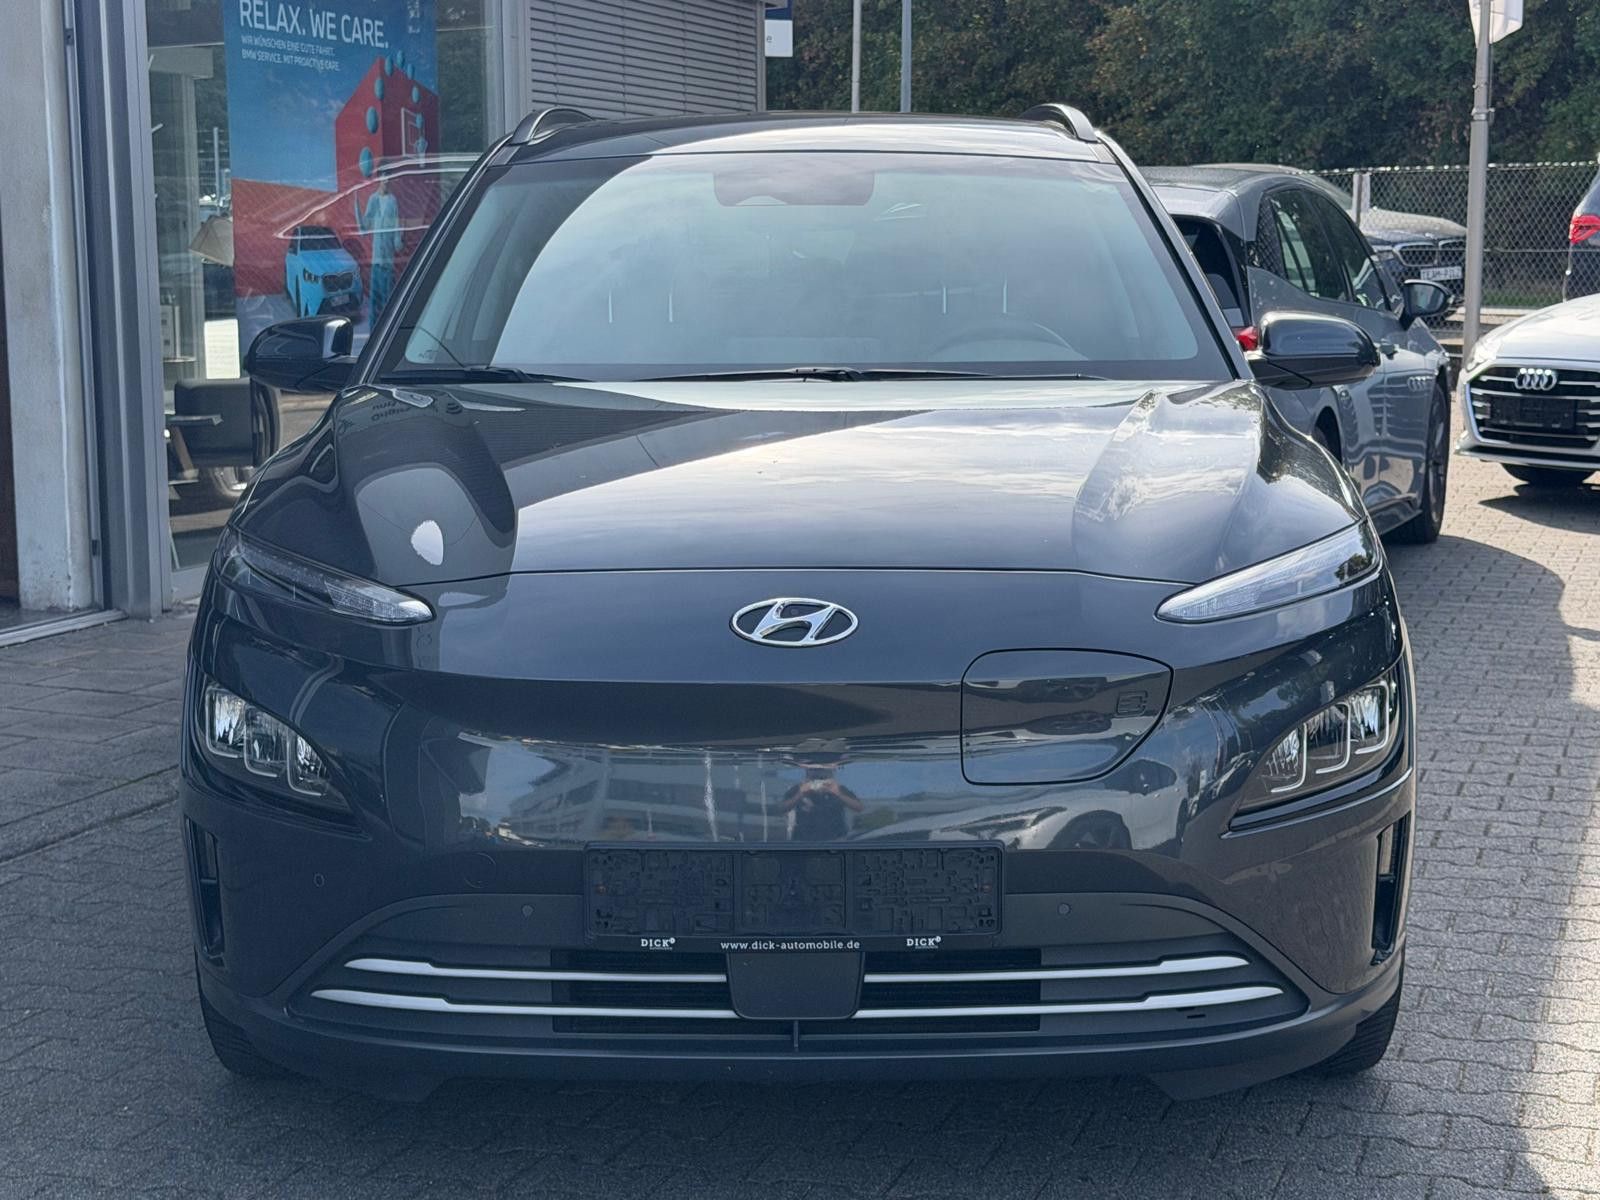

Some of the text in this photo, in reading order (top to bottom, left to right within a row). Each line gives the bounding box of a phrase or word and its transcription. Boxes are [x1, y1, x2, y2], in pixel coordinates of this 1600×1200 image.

[239, 0, 306, 36] RELAX.
[309, 8, 338, 41] WE
[341, 14, 389, 49] CARE.
[241, 48, 257, 60] BMW
[641, 938, 671, 947] DICK
[720, 940, 860, 950] www.dick-automobile.de
[906, 937, 936, 947] DICK
